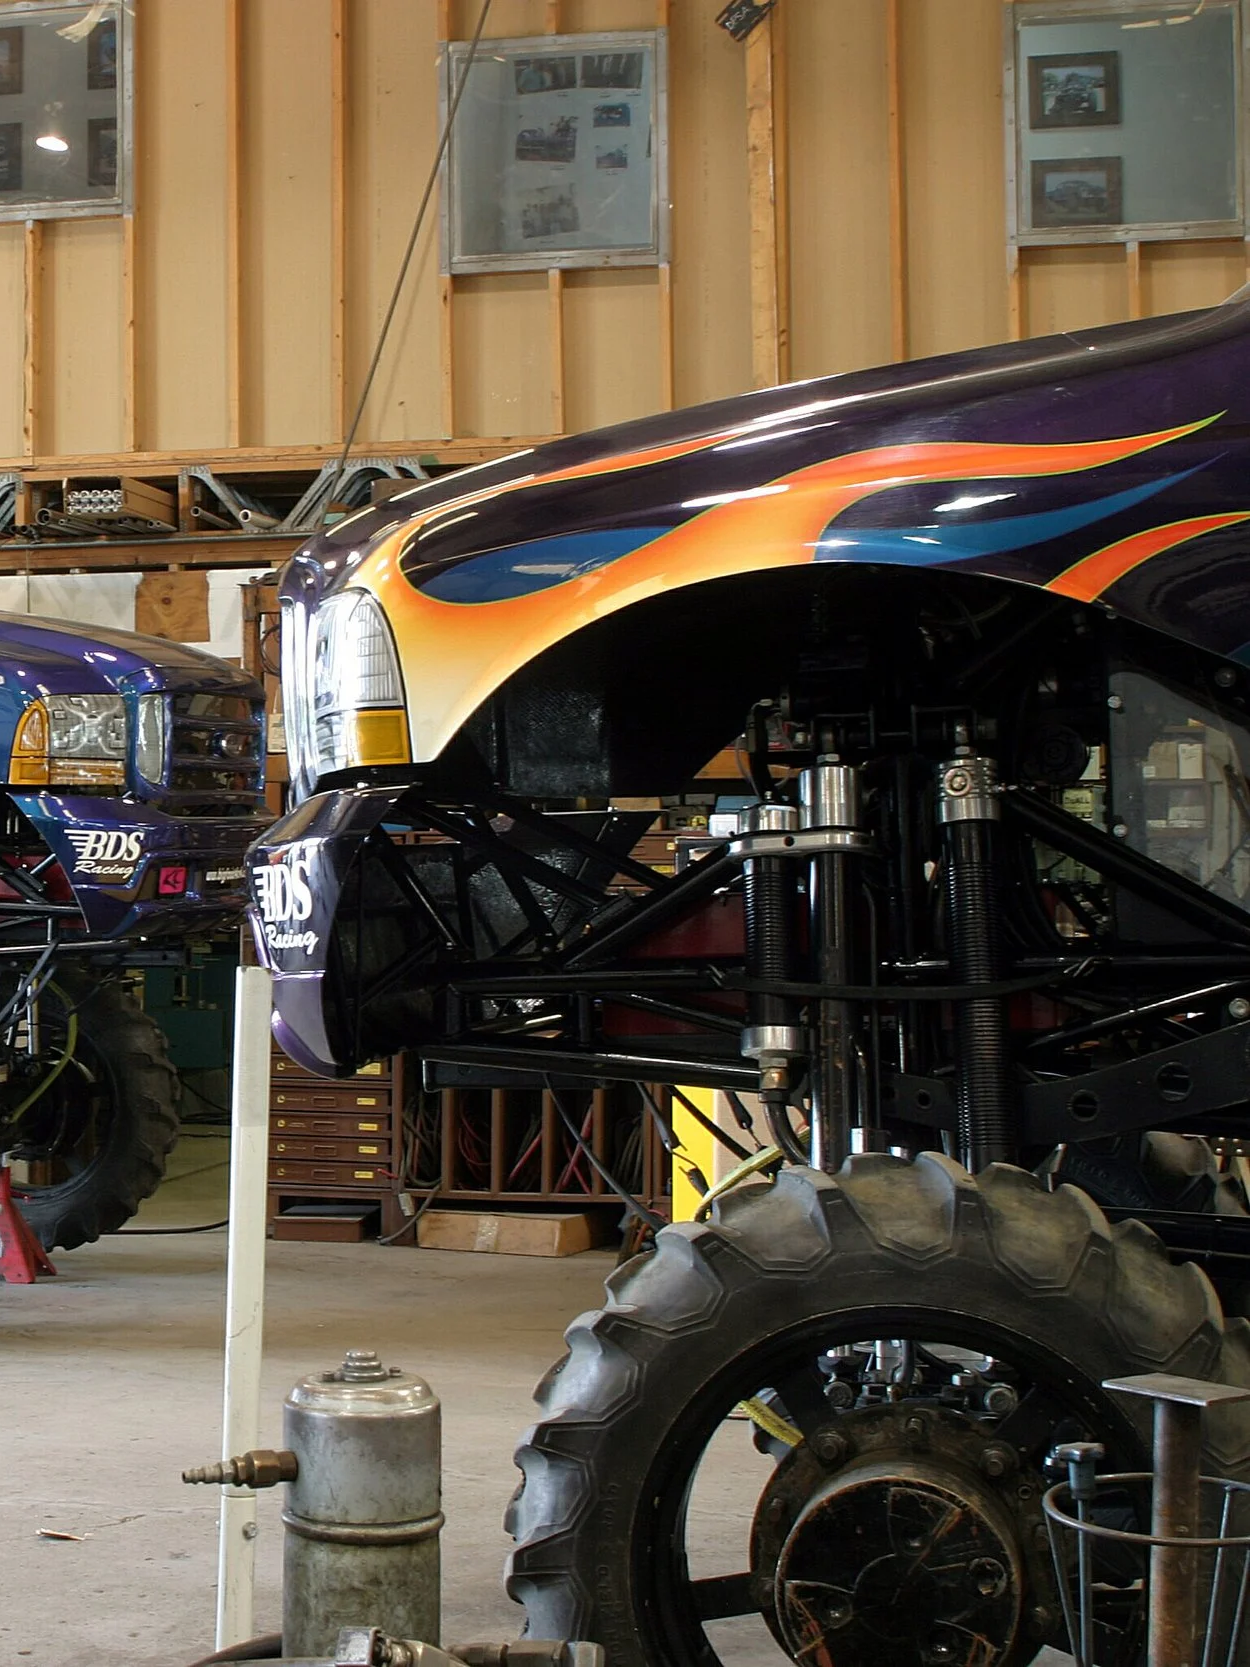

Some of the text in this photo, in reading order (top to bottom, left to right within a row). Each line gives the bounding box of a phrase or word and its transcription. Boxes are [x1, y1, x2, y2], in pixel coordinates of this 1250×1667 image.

[64, 829, 144, 862] BDS
[72, 861, 135, 880] Racing
[253, 860, 312, 922] BDS
[265, 924, 319, 955] Racing
